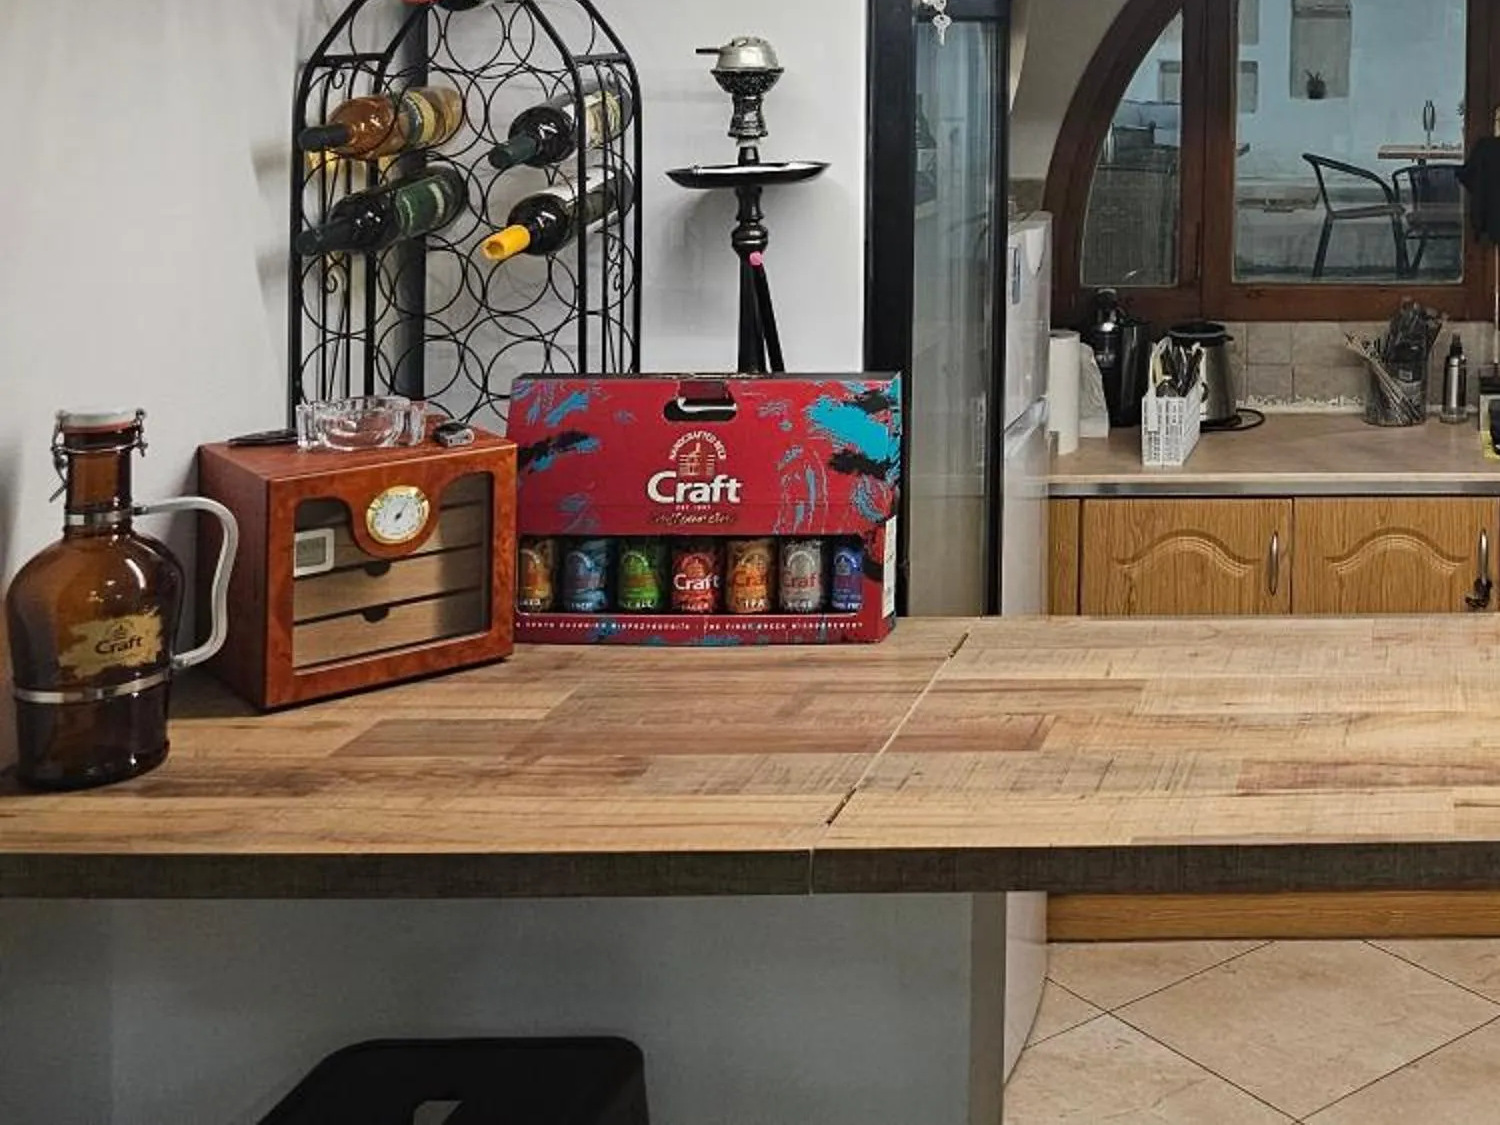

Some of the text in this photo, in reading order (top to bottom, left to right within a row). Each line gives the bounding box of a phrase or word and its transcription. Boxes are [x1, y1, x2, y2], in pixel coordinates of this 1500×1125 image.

[647, 470, 743, 505] Craft
[674, 573, 720, 590] Craft
[94, 634, 144, 655] Craft
